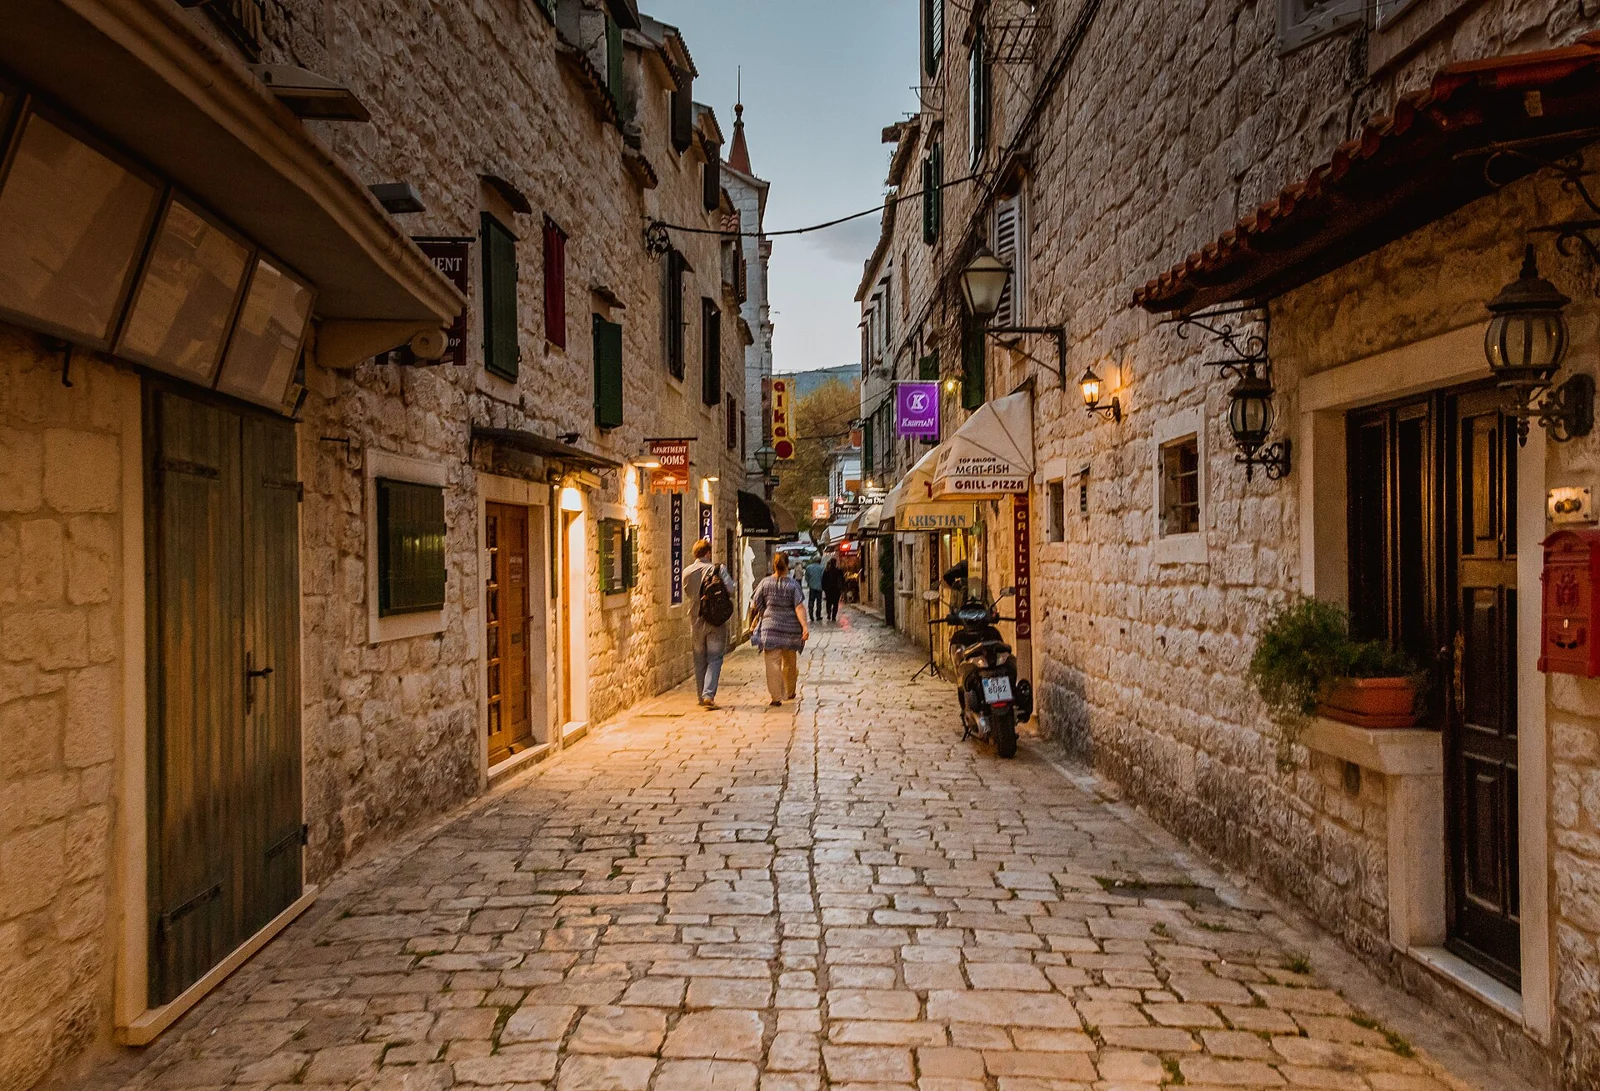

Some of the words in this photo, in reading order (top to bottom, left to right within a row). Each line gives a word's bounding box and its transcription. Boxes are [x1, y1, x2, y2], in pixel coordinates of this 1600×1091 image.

[910, 394, 926, 410] K
[652, 446, 687, 454] APARTMENT
[660, 455, 685, 465] OOMS
[955, 464, 1010, 474] MEAT-FISH
[954, 480, 1024, 490] GRILL-PIZZA
[673, 500, 681, 531] MADE
[908, 515, 966, 527] KRISTIAN
[673, 551, 681, 598] TROGIR
